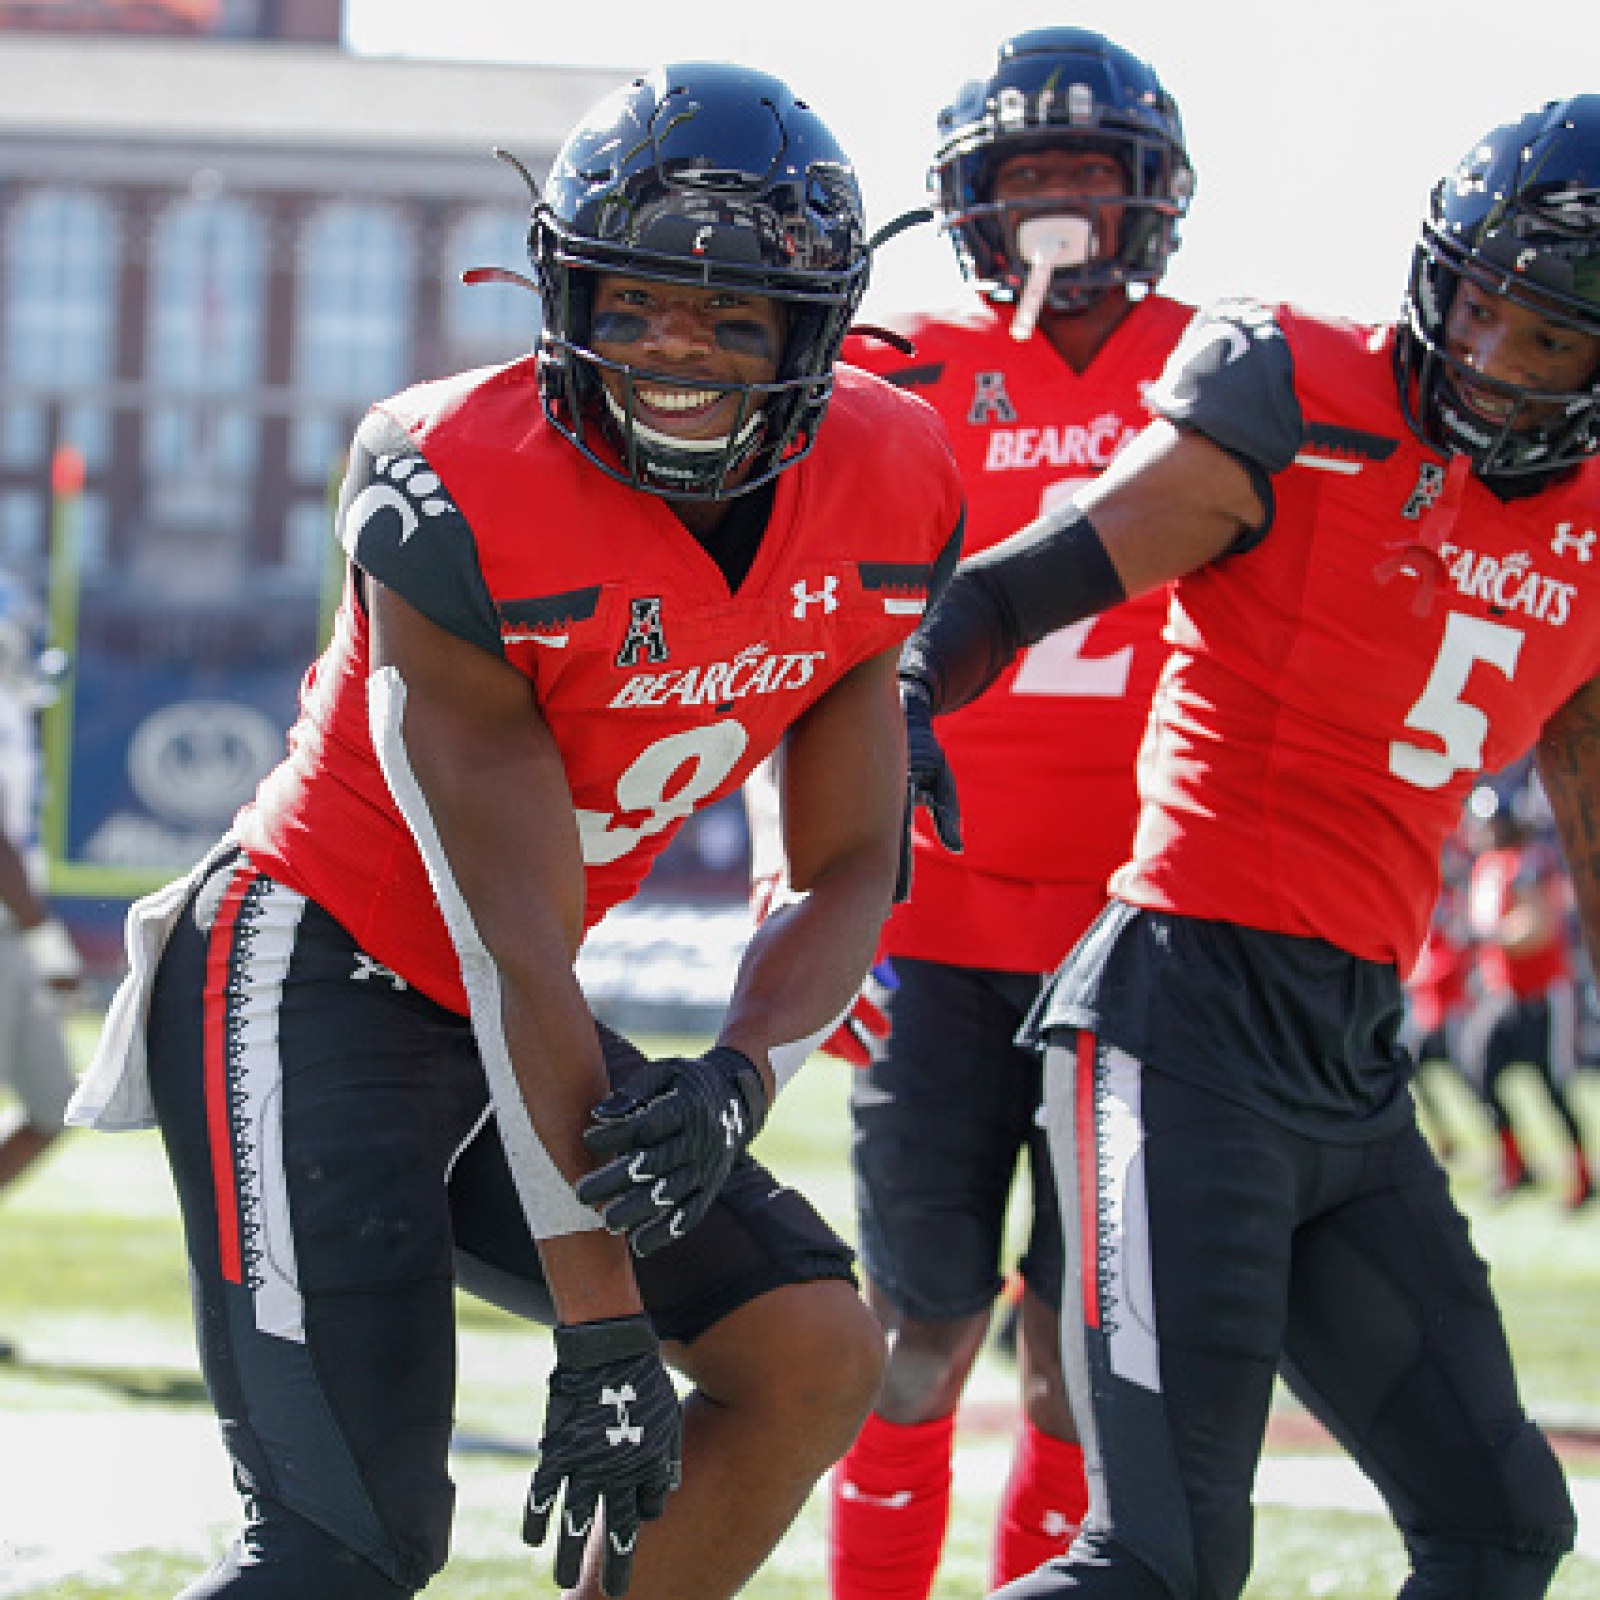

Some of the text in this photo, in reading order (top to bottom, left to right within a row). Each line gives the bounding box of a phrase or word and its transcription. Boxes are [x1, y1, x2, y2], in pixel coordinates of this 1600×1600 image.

[983, 412, 1140, 471] BEARC
[606, 641, 826, 708] BEARCATS
[1388, 610, 1526, 789] 5
[575, 718, 749, 863] 9
